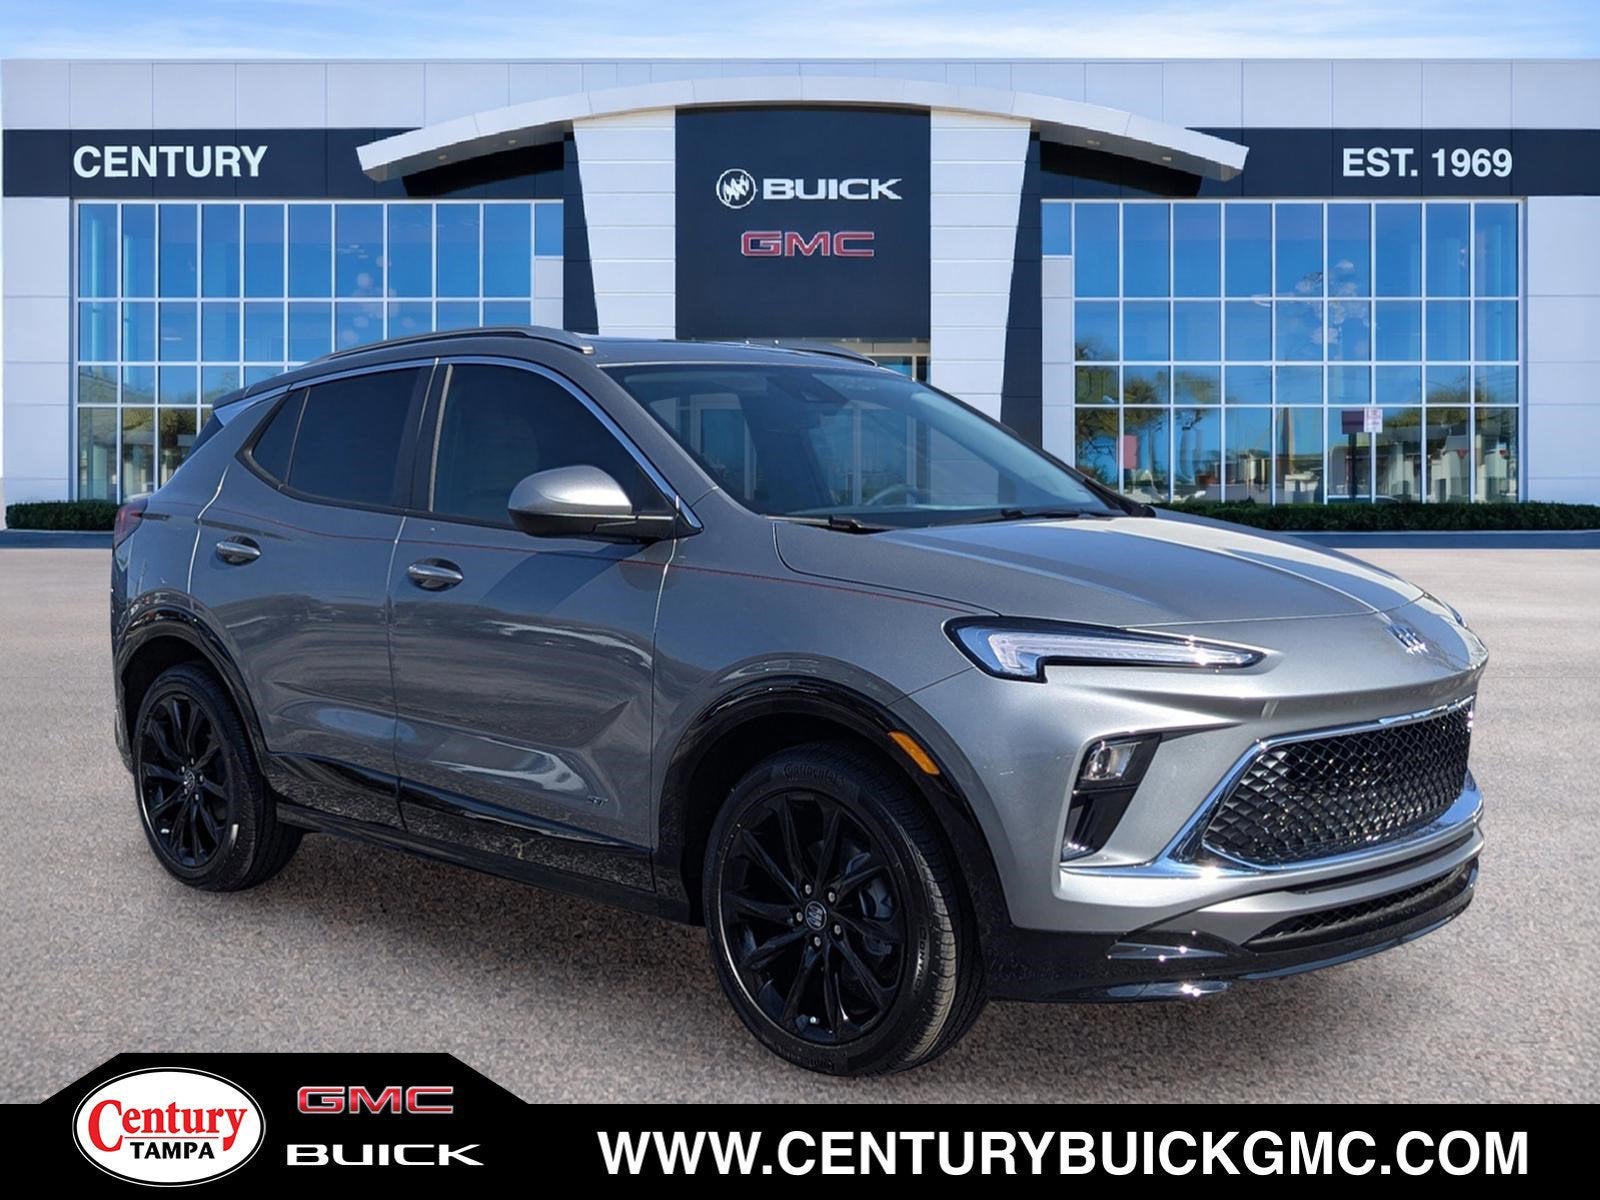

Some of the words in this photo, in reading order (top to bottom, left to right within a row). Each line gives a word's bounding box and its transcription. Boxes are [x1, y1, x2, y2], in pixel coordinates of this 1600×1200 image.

[73, 145, 268, 179] CENTURY
[1342, 148, 1418, 178] EST.
[1431, 148, 1513, 178] 1969
[762, 178, 903, 200] BUICK
[740, 230, 875, 257] GMC
